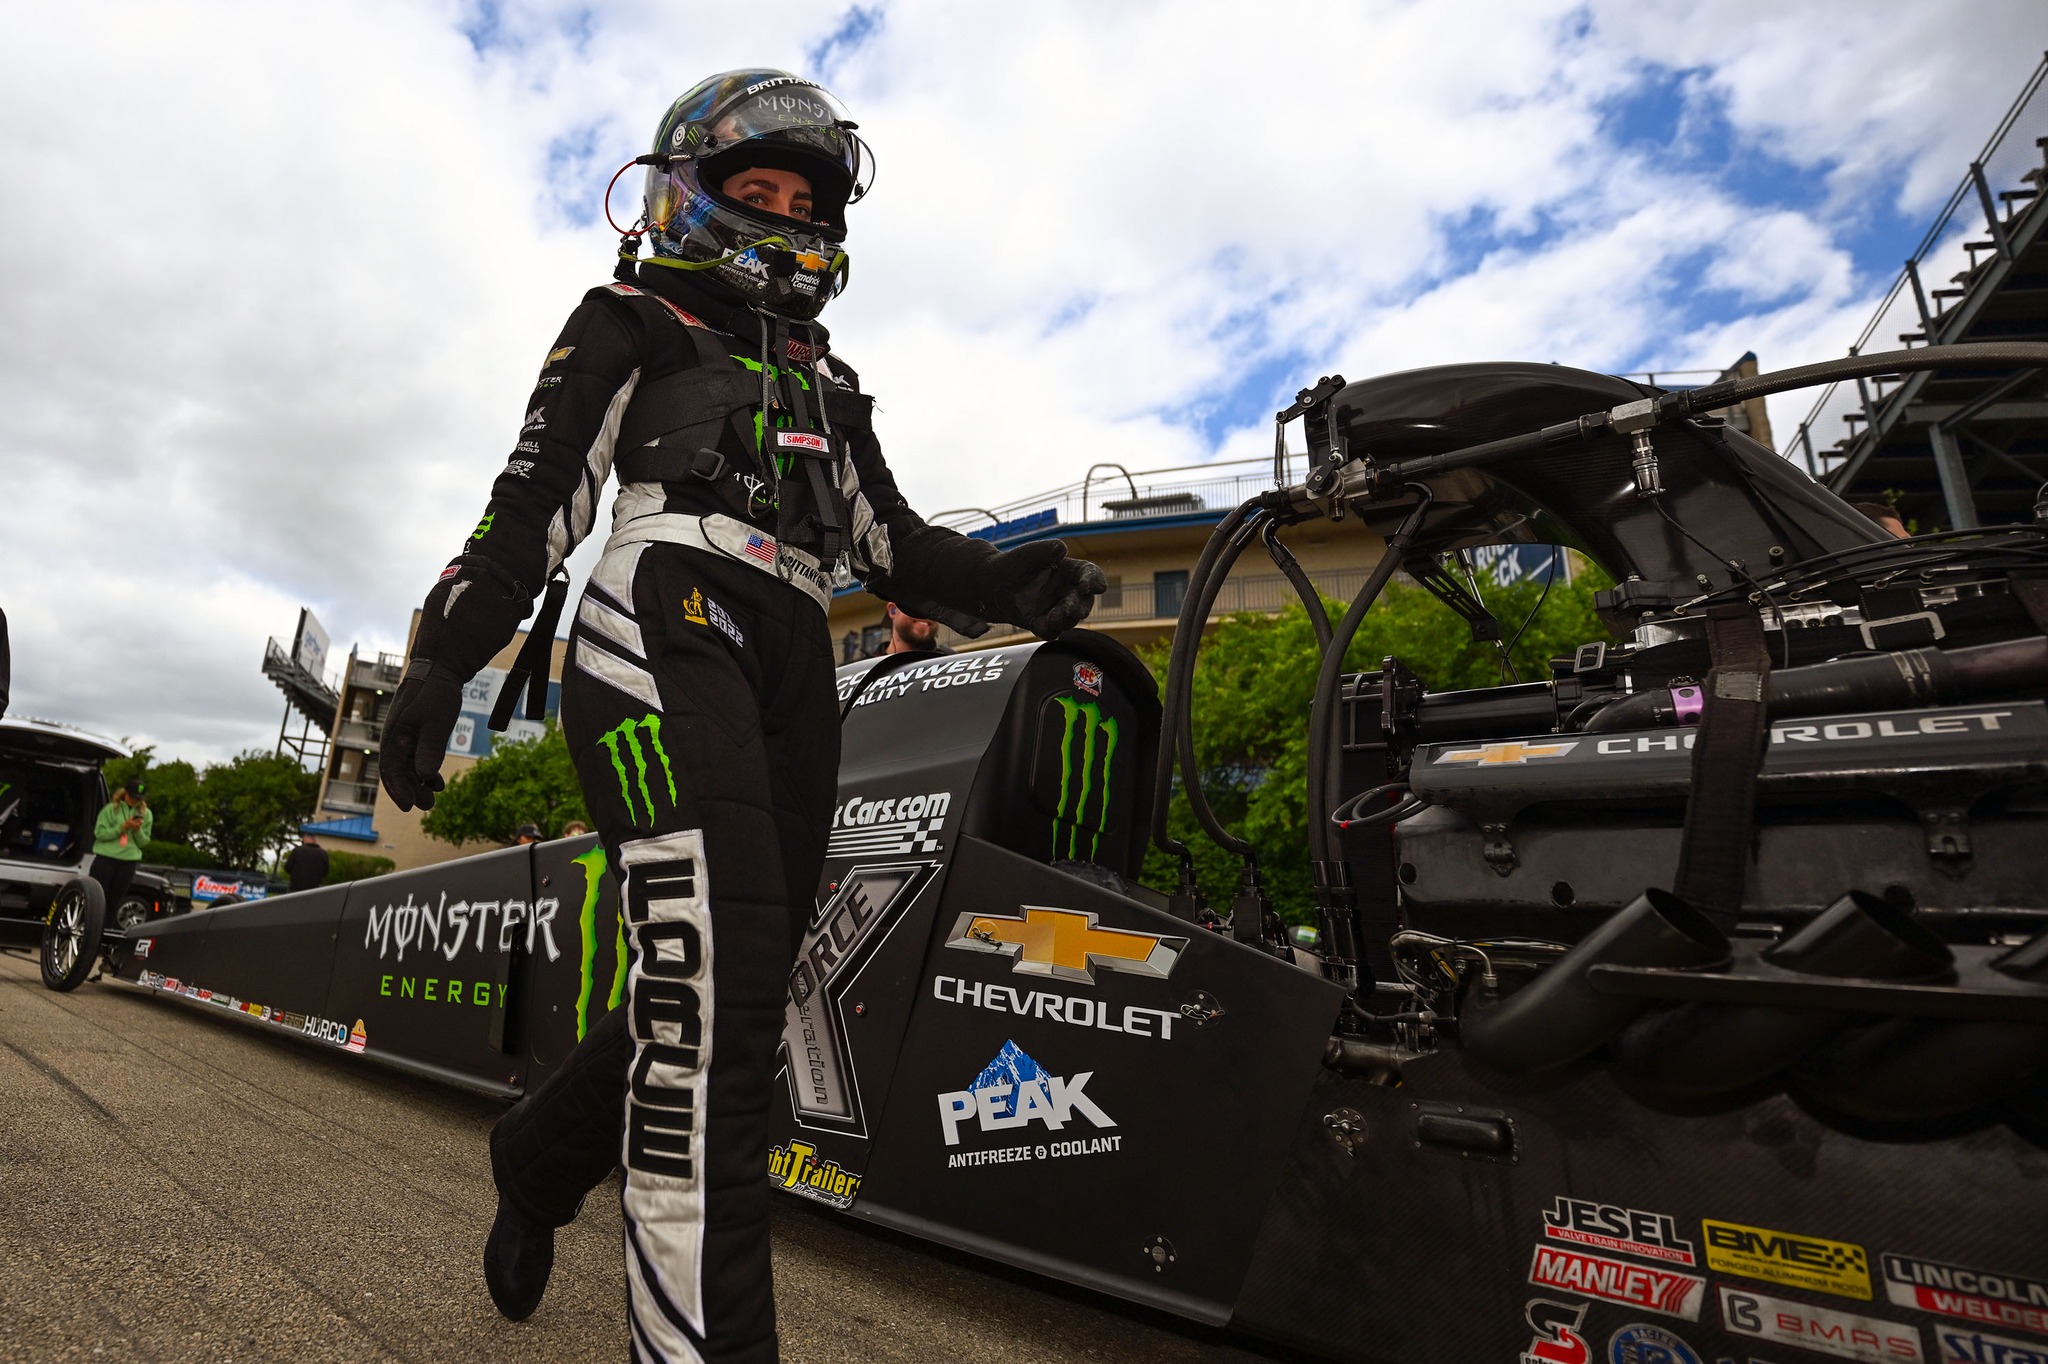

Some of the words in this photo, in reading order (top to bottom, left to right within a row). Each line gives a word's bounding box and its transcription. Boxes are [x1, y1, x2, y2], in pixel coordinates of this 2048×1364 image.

[786, 435, 821, 447] SIMPSON
[709, 610, 744, 648] 2022
[920, 668, 1004, 693] TOOLS
[789, 881, 875, 1008] ORCE
[380, 975, 508, 1008] ENERGY
[934, 975, 1182, 1040] CHEVROLET
[302, 1015, 347, 1043] HURCO
[628, 858, 701, 1178] FORCE
[937, 1071, 1118, 1146] PEAK
[948, 1146, 1031, 1168] ANTIFREEZE
[1050, 1136, 1121, 1158] COOLANT
[1545, 1199, 1691, 1252] JESEL
[1558, 1229, 1587, 1242] VALVE
[1588, 1235, 1618, 1248] TRAIN
[1620, 1240, 1684, 1262] INNOVATION
[1707, 1225, 1832, 1268] BME
[1538, 1252, 1671, 1305] MANLEY
[1711, 1258, 1760, 1274] FORGED
[1763, 1267, 1829, 1288] ALUMINUM
[1832, 1281, 1868, 1296] RODS
[1776, 1312, 1917, 1358] BMRS
